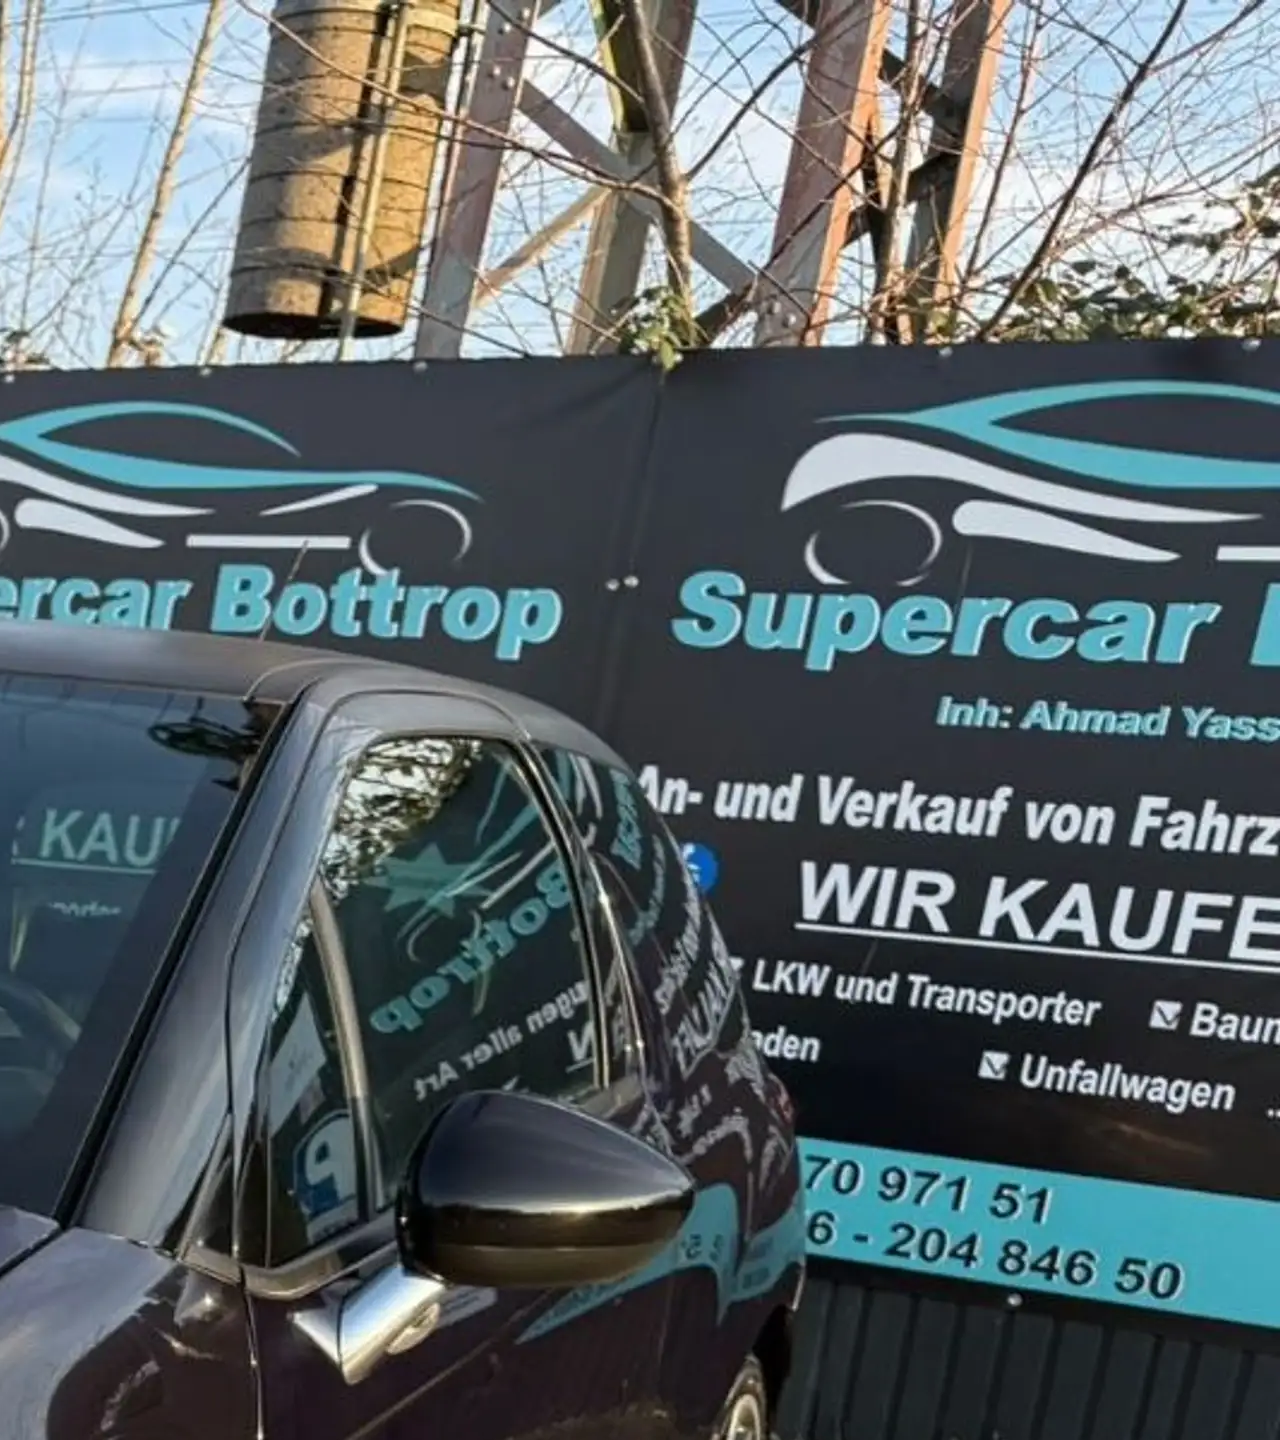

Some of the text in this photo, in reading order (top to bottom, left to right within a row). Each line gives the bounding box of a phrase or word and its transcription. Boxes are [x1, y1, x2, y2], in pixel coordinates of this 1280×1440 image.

[210, 563, 563, 661] Bottrop
[671, 570, 1221, 671] Supercar
[936, 696, 1013, 729] Inh:
[1020, 698, 1171, 737] Ahmad
[39, 808, 181, 867] KAU
[714, 773, 805, 823] und
[817, 773, 1014, 838] Verkauf
[1026, 799, 1114, 846] von
[1128, 796, 1280, 856] Fahrz
[800, 860, 1280, 963] WIR KAUFE
[752, 958, 1101, 1027] LKW und Transporter
[1019, 1053, 1236, 1115] Unfallwagen
[877, 1164, 972, 1212] 971
[989, 1182, 1051, 1225] 51
[882, 1220, 982, 1268] 204
[997, 1236, 1097, 1287] 846
[1115, 1256, 1183, 1300] 50
